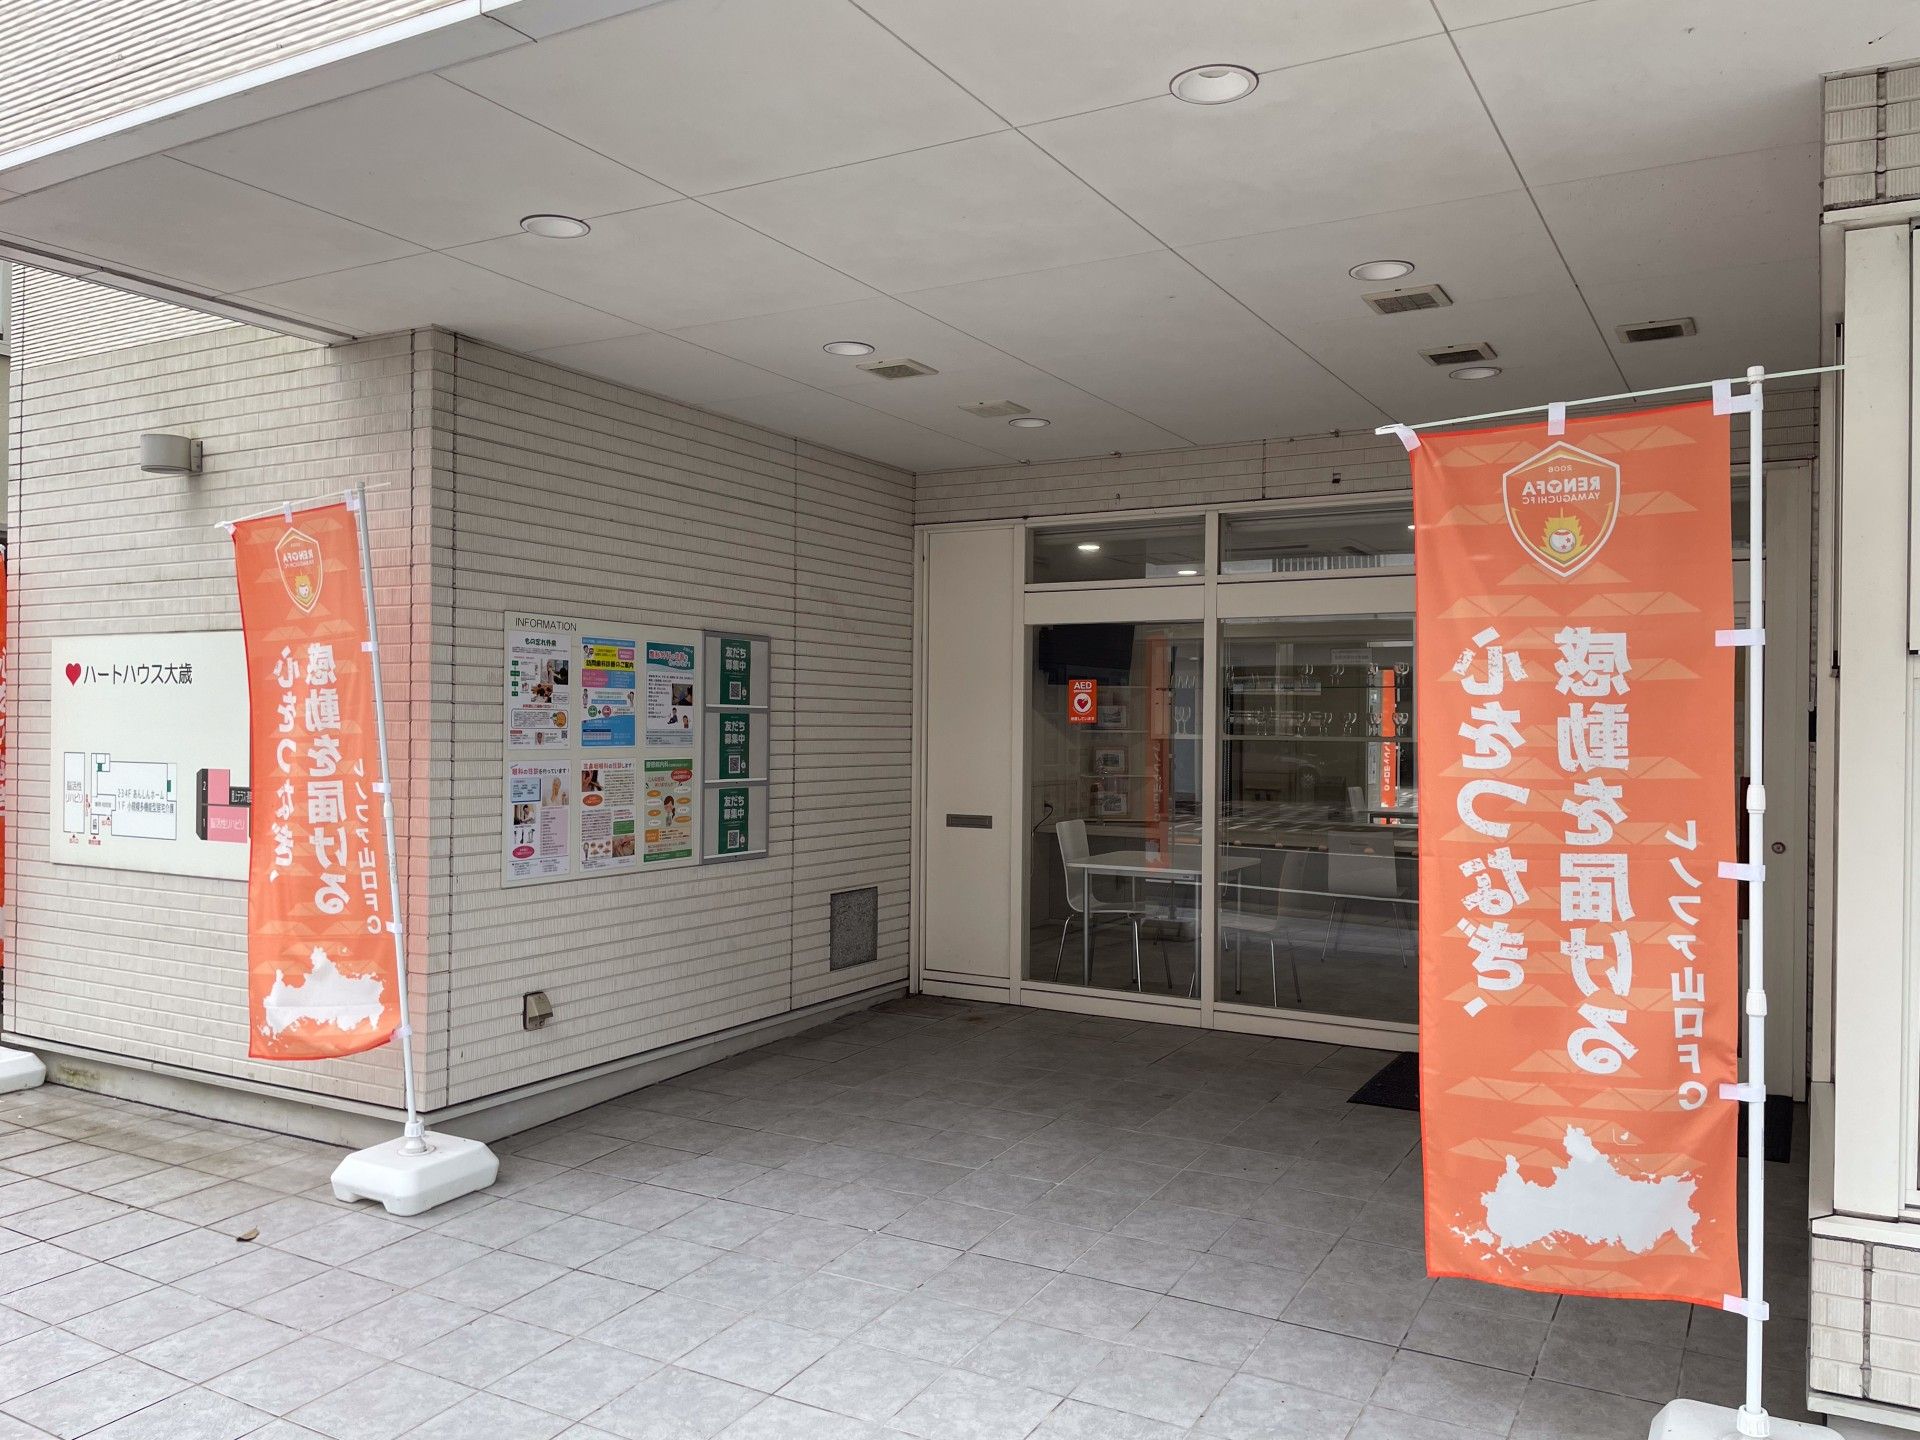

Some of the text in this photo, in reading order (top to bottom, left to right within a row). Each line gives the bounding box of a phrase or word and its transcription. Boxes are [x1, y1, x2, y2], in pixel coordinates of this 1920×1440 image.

[515, 617, 577, 631] INFORMATION
[725, 646, 747, 659] 友だち
[84, 662, 192, 685] ハートハウス大歳
[1073, 681, 1093, 690] AED
[724, 721, 746, 732] 友だち
[723, 795, 745, 807] 友だち
